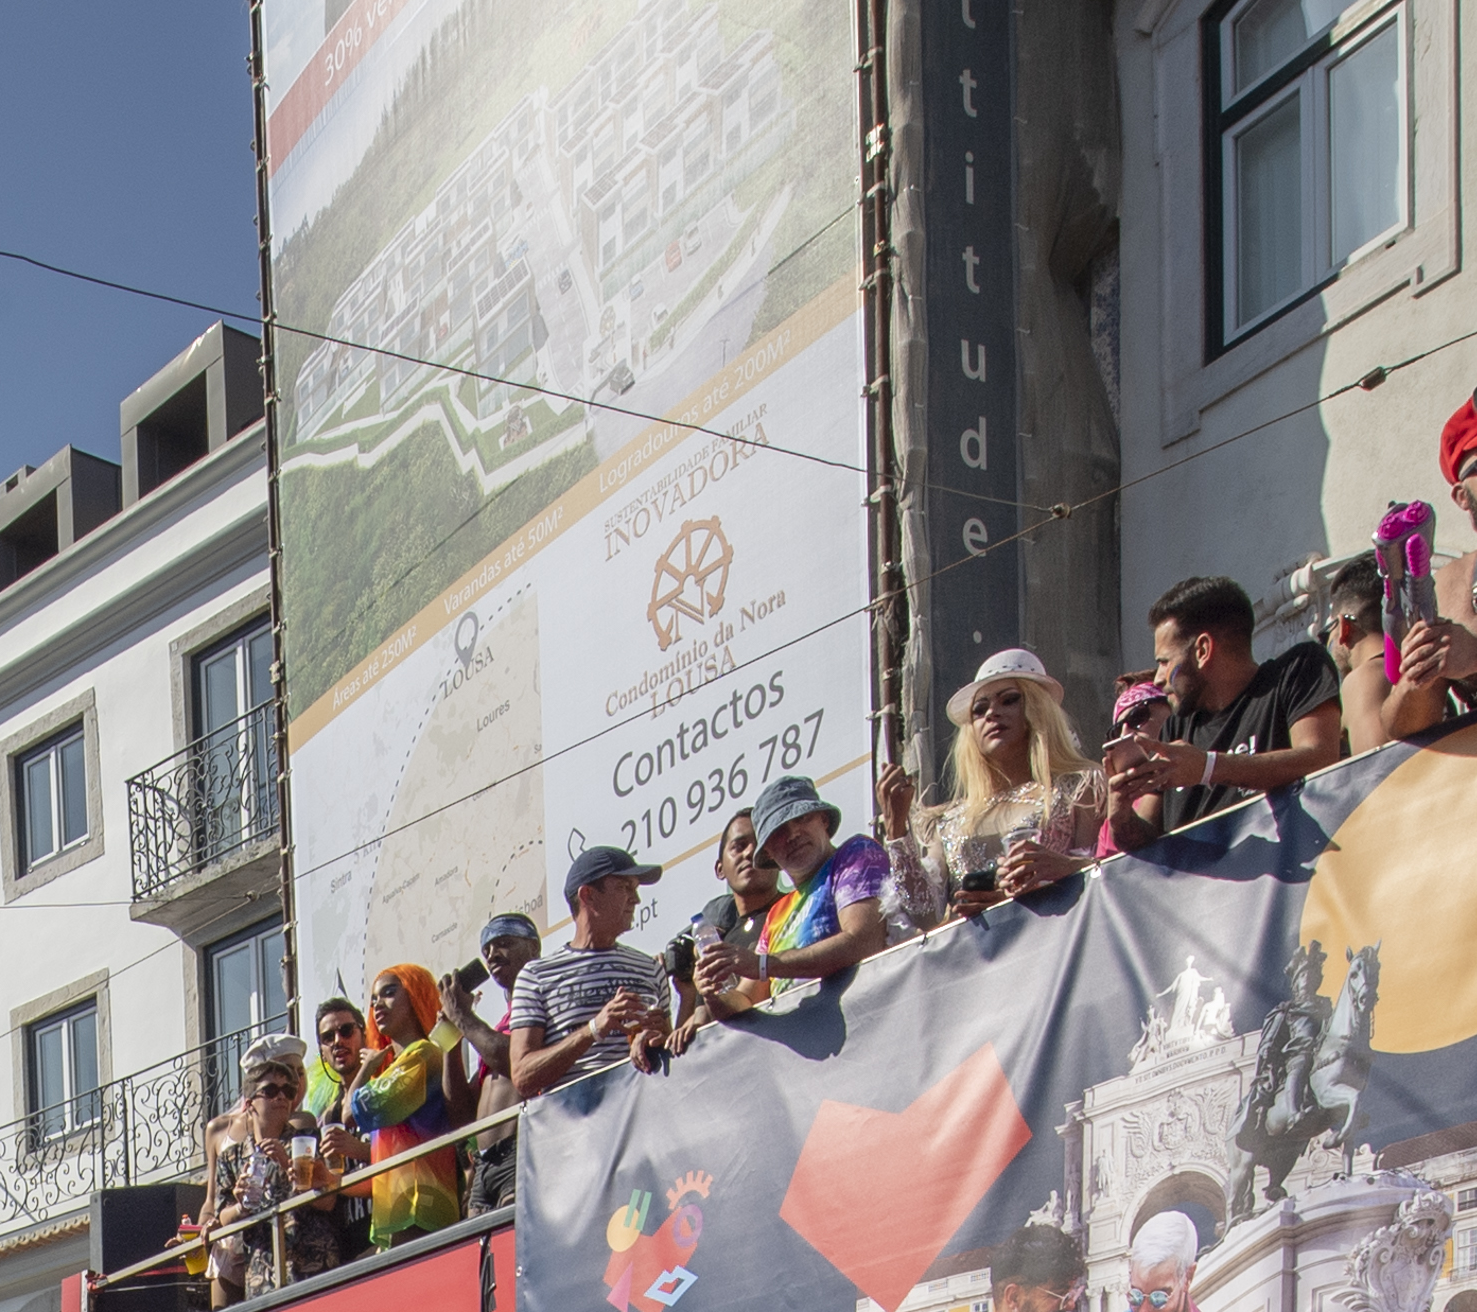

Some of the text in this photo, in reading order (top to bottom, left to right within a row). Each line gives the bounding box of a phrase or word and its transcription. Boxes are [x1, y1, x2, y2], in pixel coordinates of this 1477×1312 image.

[325, 20, 362, 86] 30%
[599, 403, 699, 494] Logradouros
[703, 380, 730, 413] até
[604, 403, 768, 532] SUSTENTABILIDADE FAMILIAR
[605, 422, 770, 562] INOVADORA
[443, 559, 502, 615] Varandas
[504, 536, 525, 566] até
[332, 671, 361, 711] Áreas
[363, 657, 380, 682] até
[438, 646, 495, 700] LOUSA
[605, 590, 786, 717] Condomínio da Nora
[650, 645, 736, 720] LOUSA
[477, 699, 510, 732] Loures
[612, 670, 785, 798] Contactos
[621, 708, 824, 858] 210 936 787
